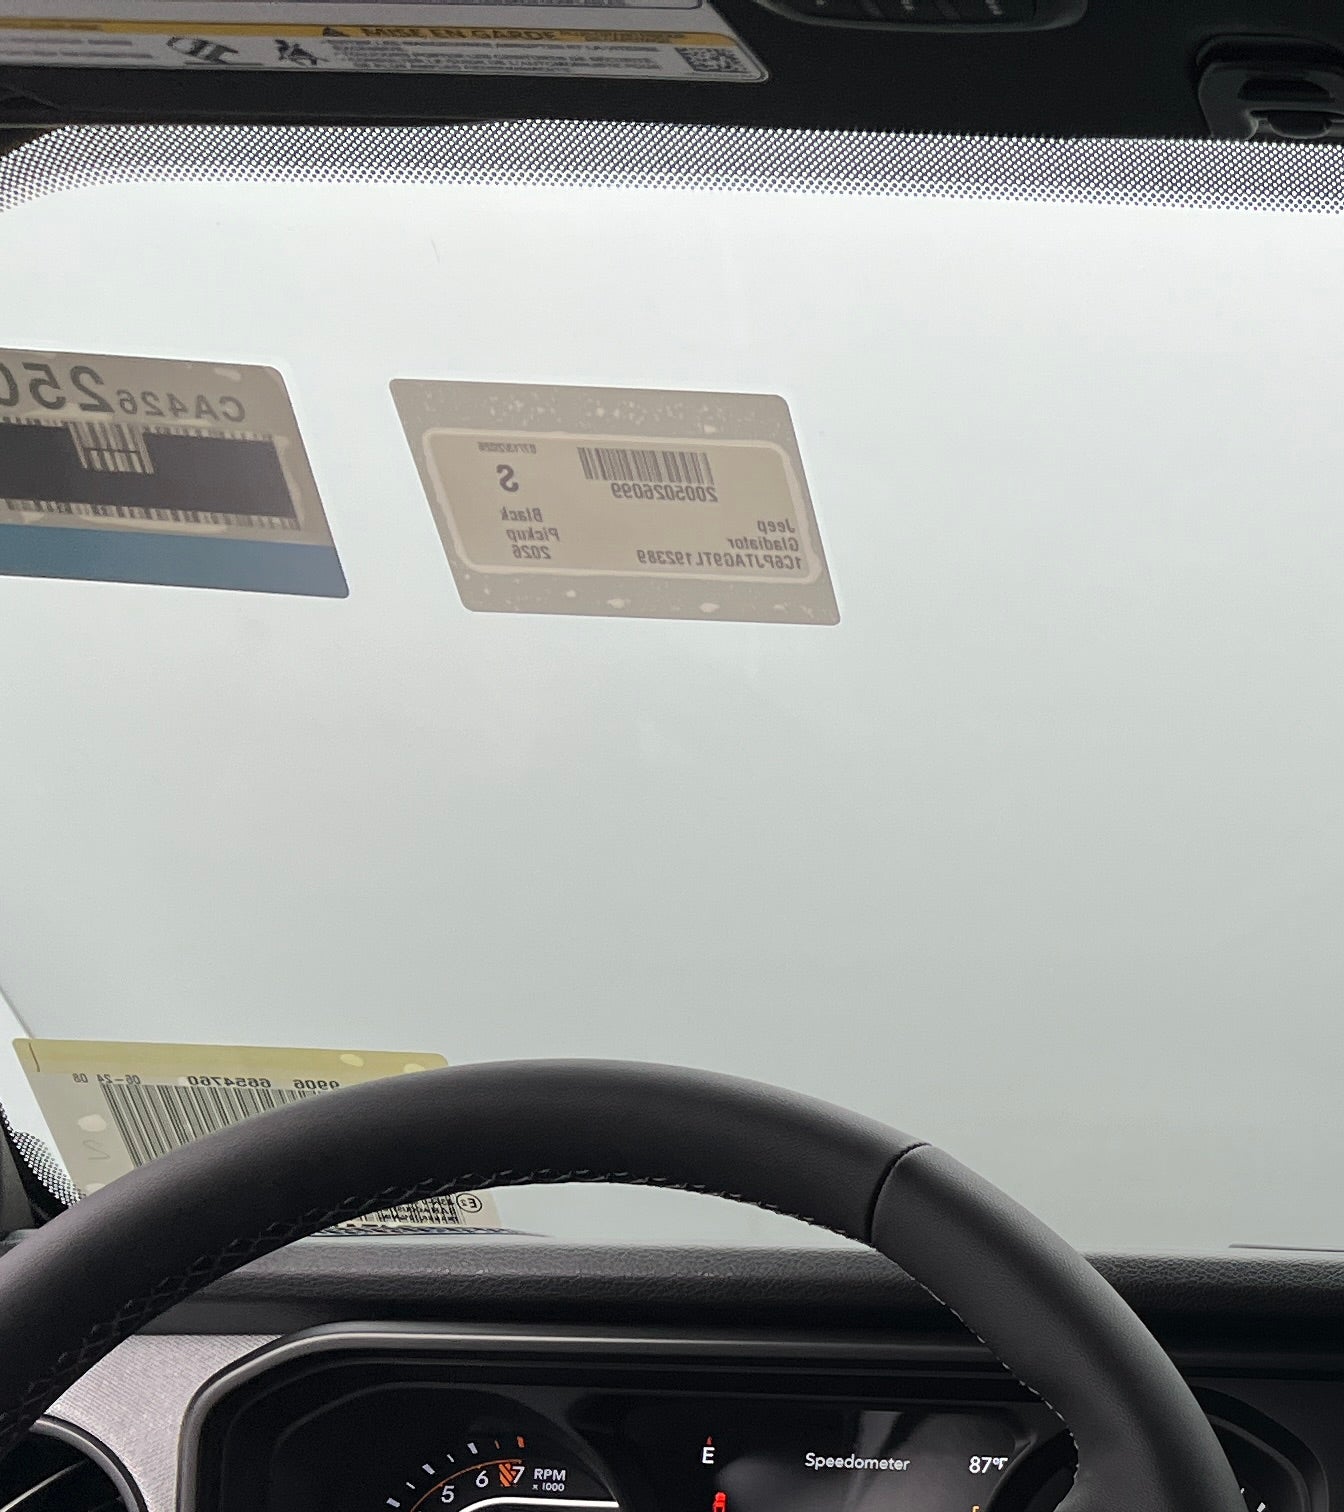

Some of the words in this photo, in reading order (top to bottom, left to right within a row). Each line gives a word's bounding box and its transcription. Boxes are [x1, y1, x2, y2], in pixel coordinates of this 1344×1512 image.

[702, 1447, 714, 1464] E
[805, 1453, 910, 1472] Speedometer
[476, 1470, 489, 1487] 6
[512, 1466, 525, 1483] 7
[534, 1468, 566, 1481] RPM
[441, 1485, 455, 1503] 5
[542, 1482, 564, 1491] 1000
